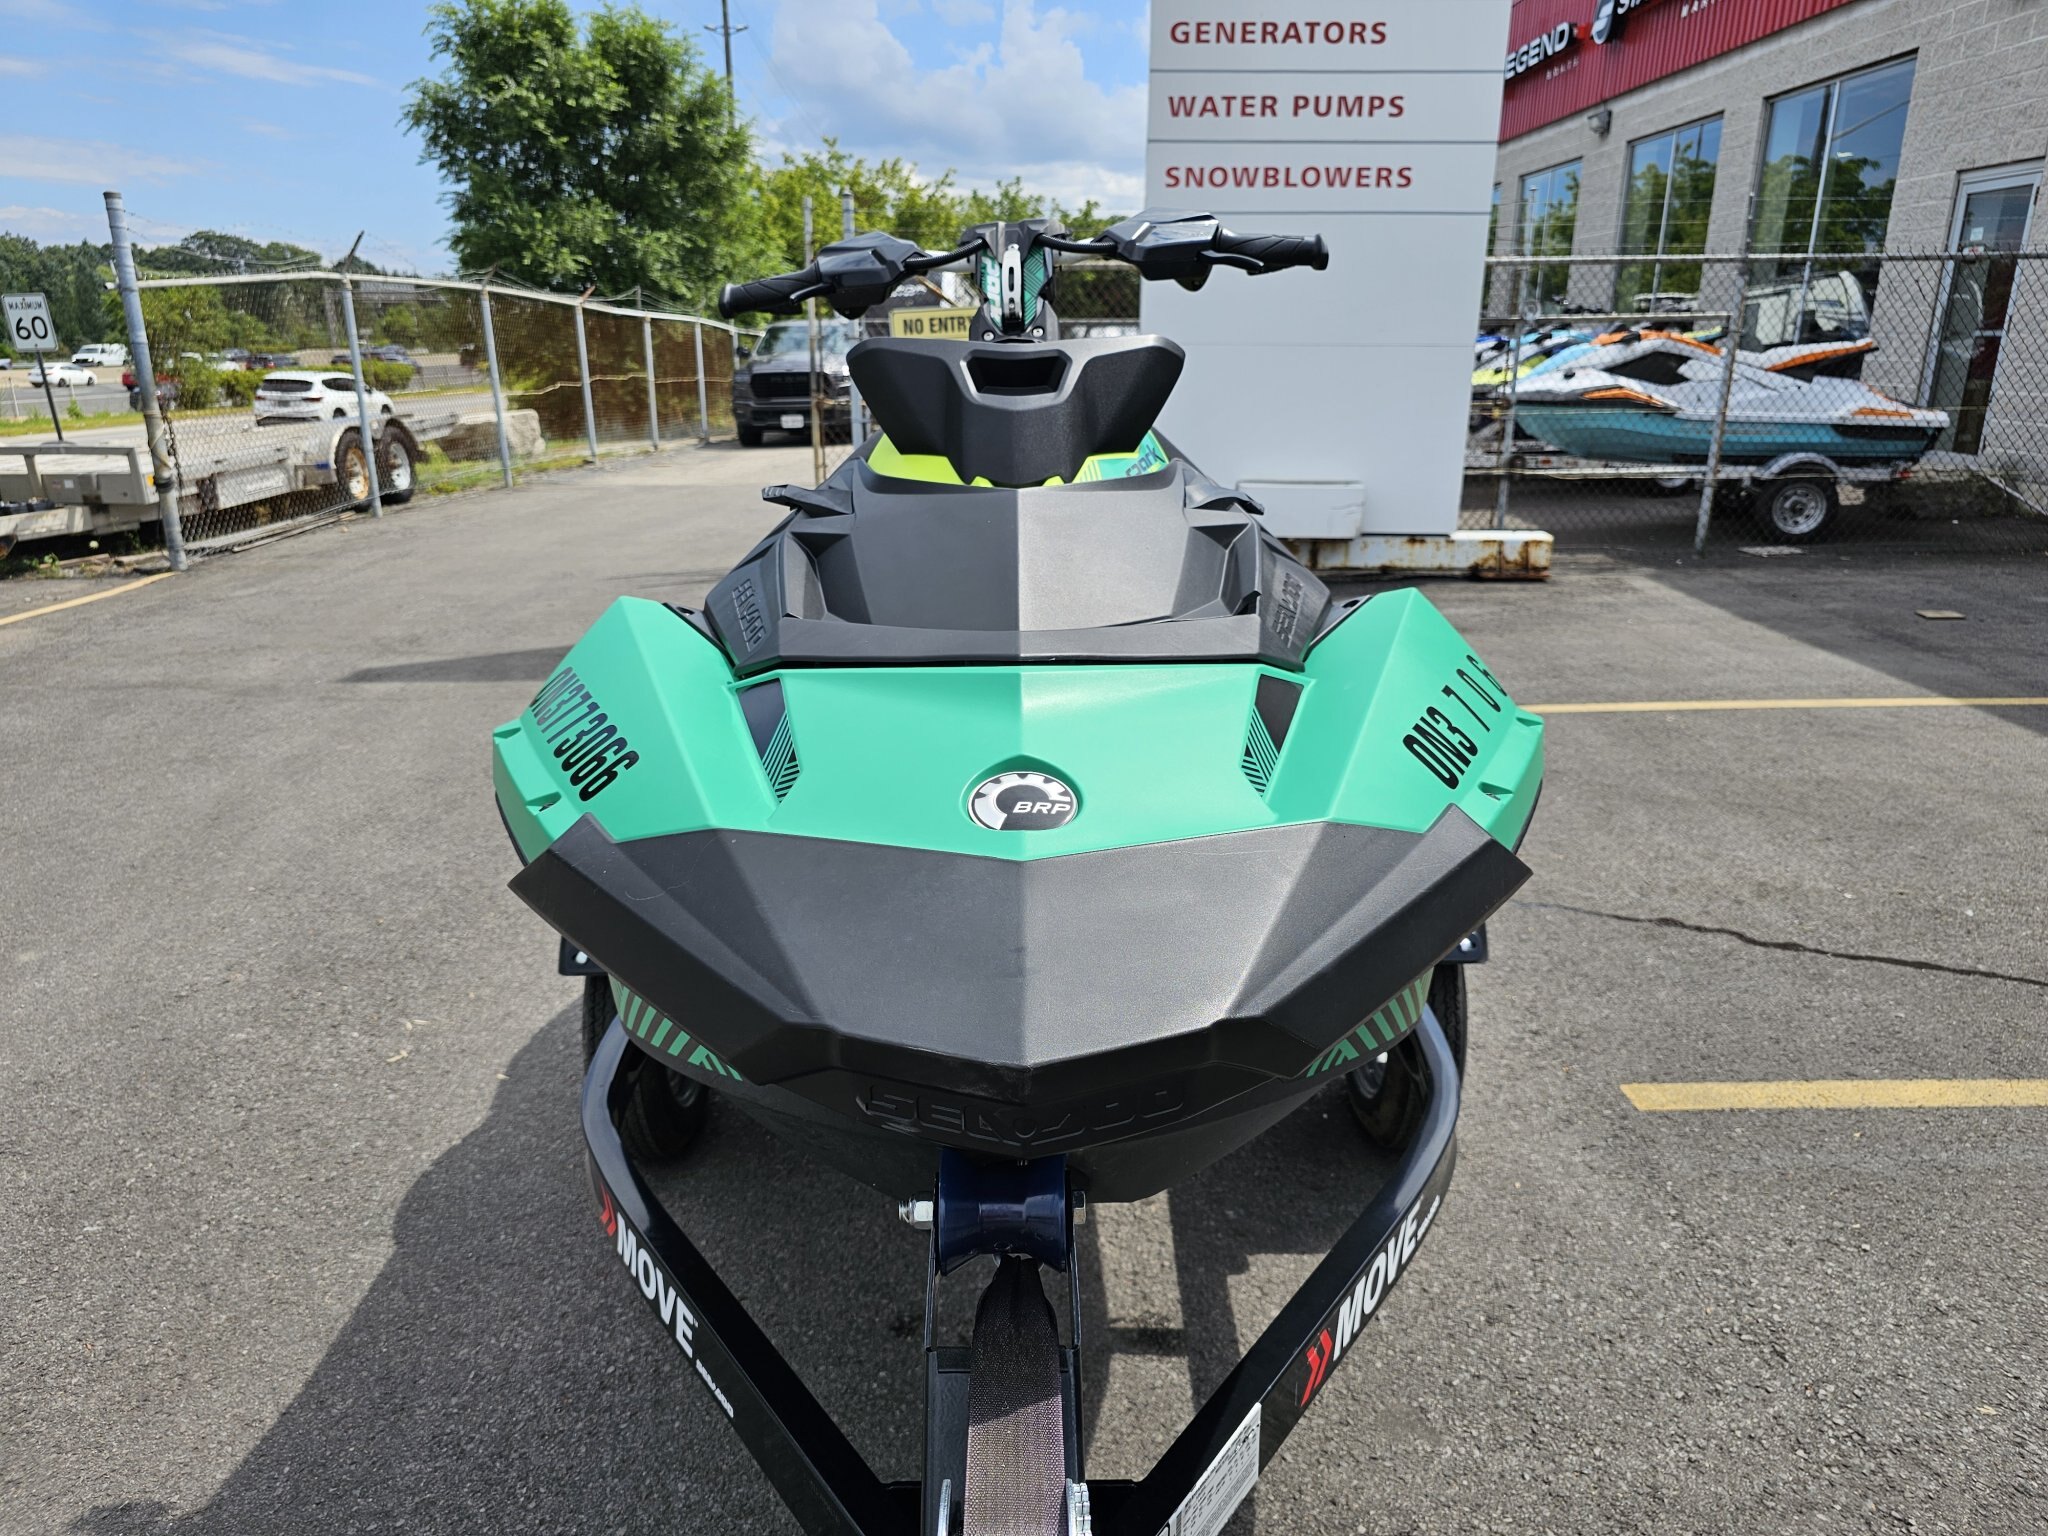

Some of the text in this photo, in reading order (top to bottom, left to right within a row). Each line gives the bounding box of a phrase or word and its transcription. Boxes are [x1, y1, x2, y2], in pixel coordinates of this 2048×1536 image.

[1170, 21, 1388, 44] GENERATORS
[1168, 95, 1405, 118] WATER PUMPS
[1164, 166, 1413, 189] SNOWBLOWERS
[8, 301, 43, 310] MAXIMUM
[15, 316, 48, 340] 60
[904, 316, 971, 336] NO ENTR
[1013, 801, 1071, 815] BRP
[616, 1211, 695, 1359] MOVE
[1332, 1198, 1421, 1361] MOVE
